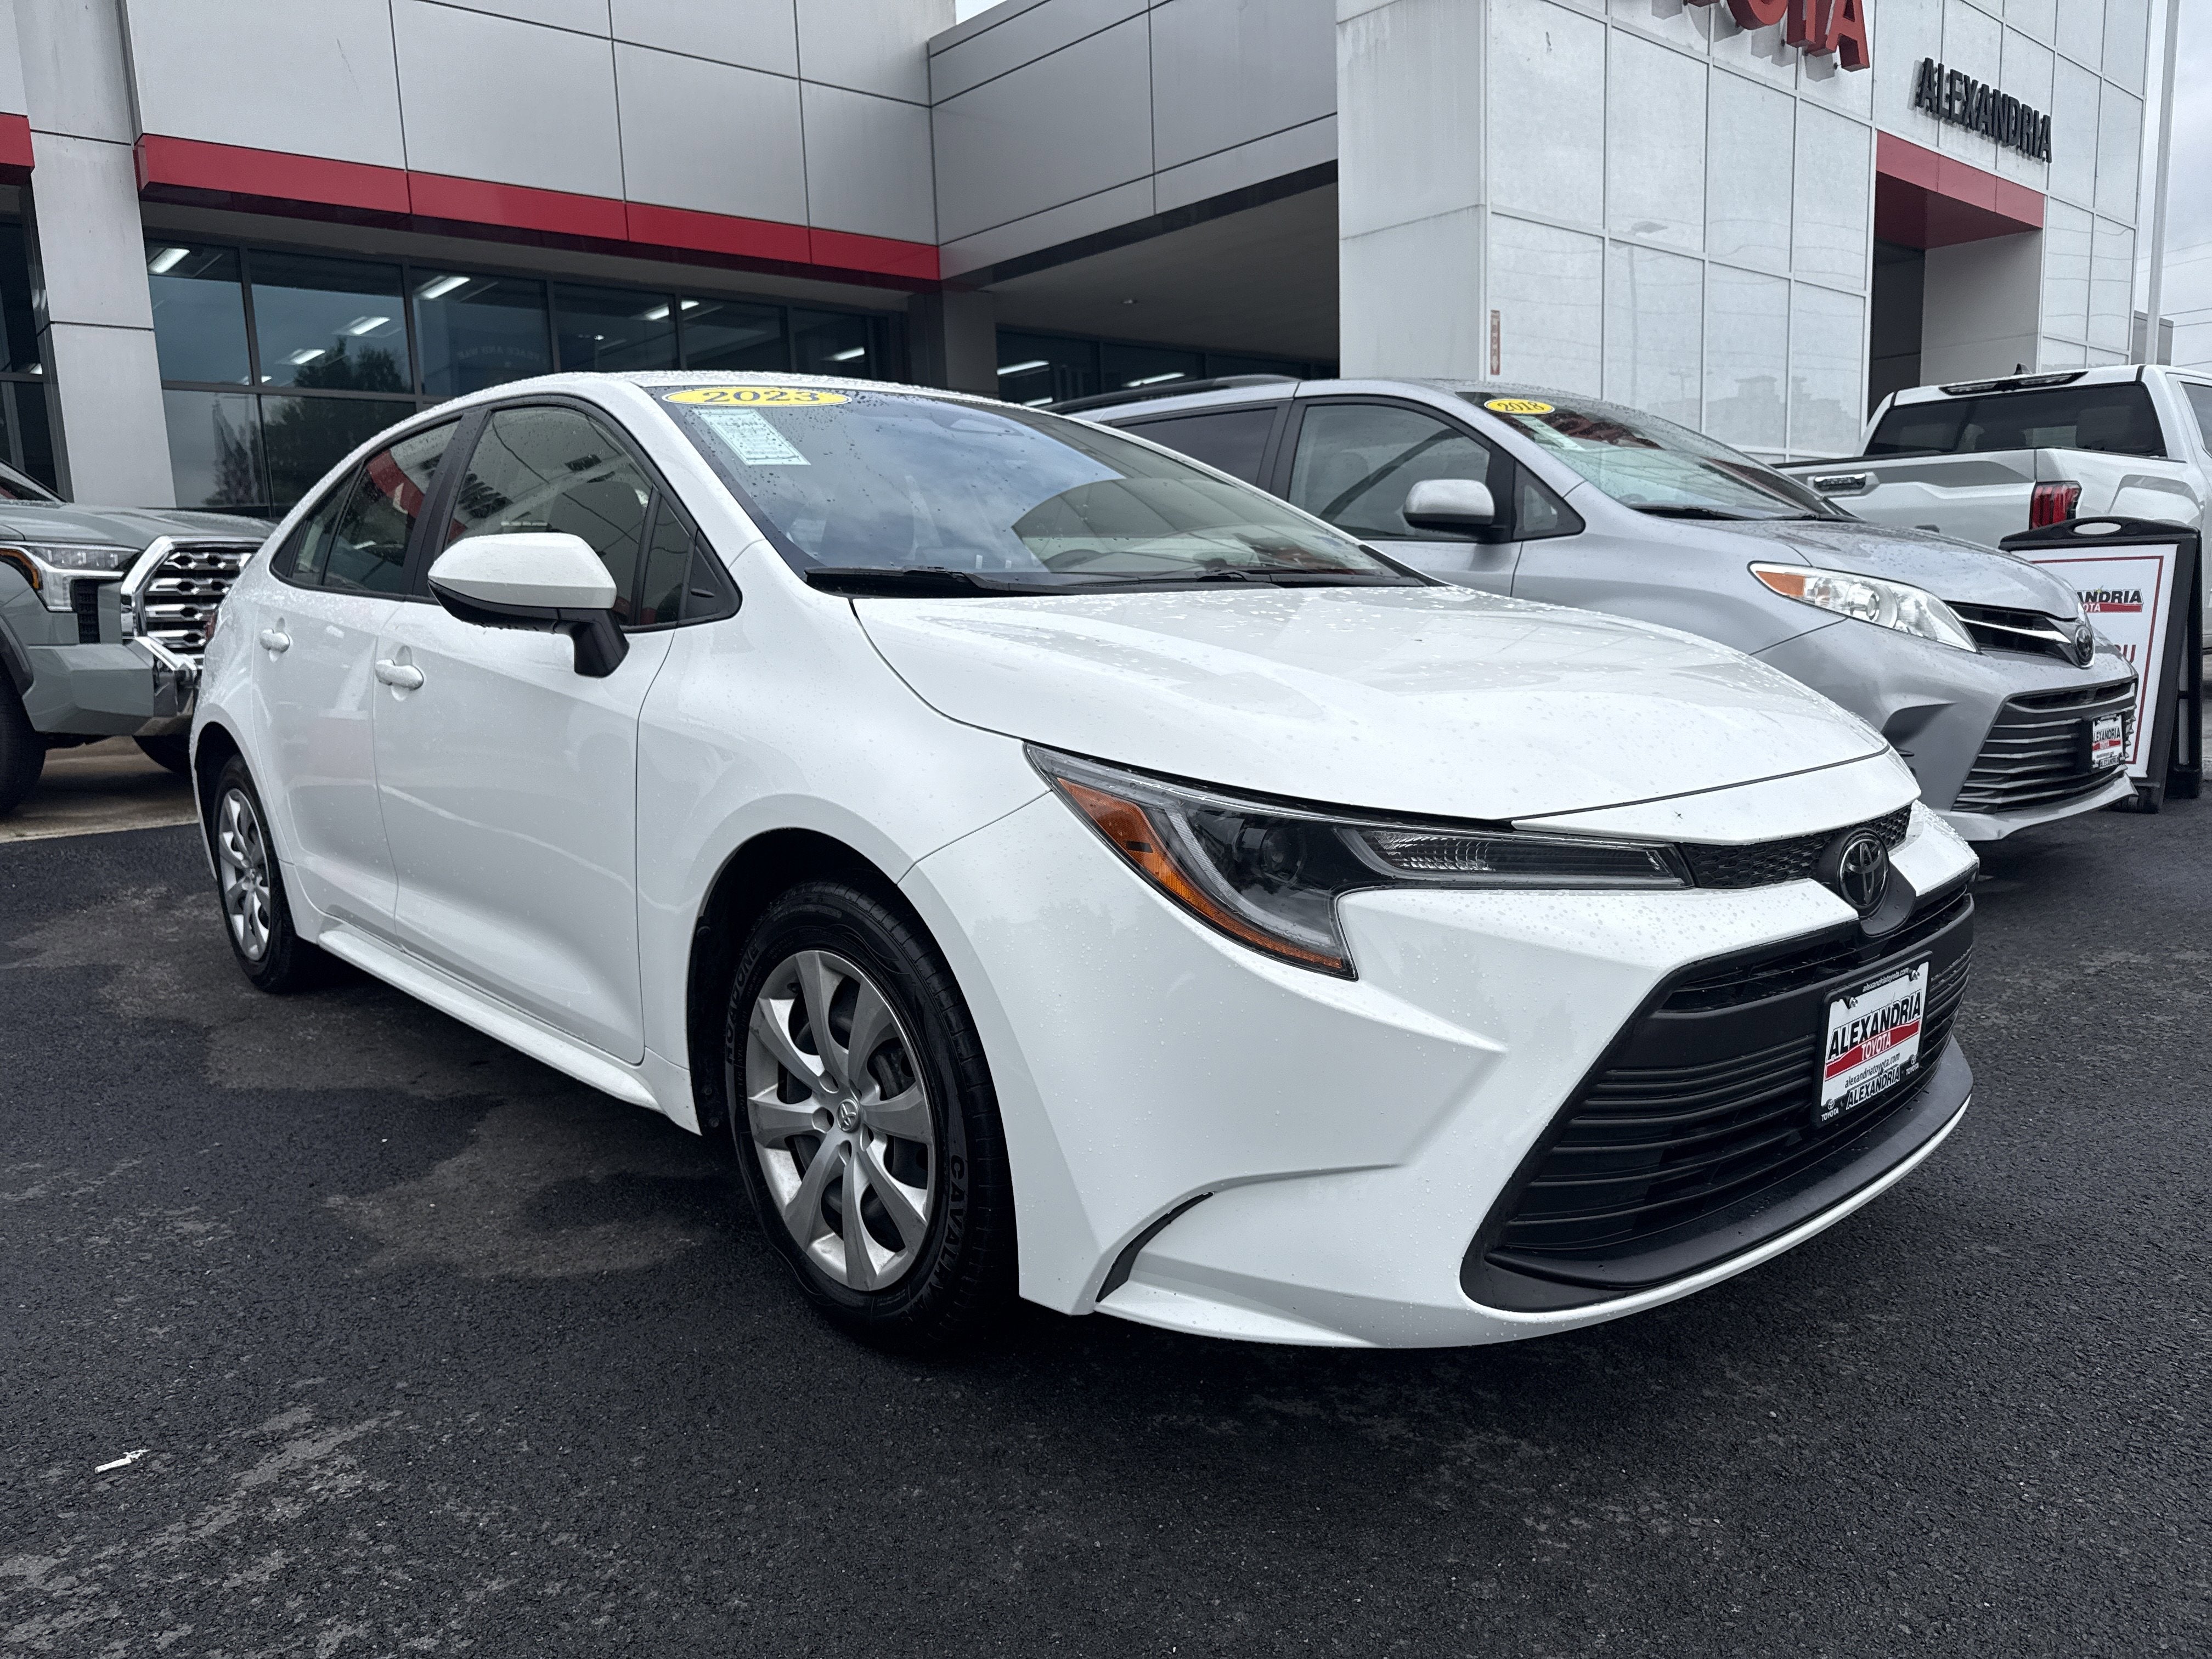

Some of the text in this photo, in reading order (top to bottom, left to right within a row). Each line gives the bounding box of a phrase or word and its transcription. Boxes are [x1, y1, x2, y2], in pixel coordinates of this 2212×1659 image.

[1916, 57, 2052, 163] ALEXANDRIA
[703, 390, 820, 403] 2023
[1497, 401, 1544, 412] 2018
[1827, 991, 1921, 1061] ALEXANDRIA
[1861, 1031, 1891, 1062] TOYOTA
[1845, 1052, 1900, 1088] alexandriatoyota.com
[1846, 1065, 1900, 1109] ALEXANDRIA
[1821, 1107, 1839, 1121] TOYOTA
